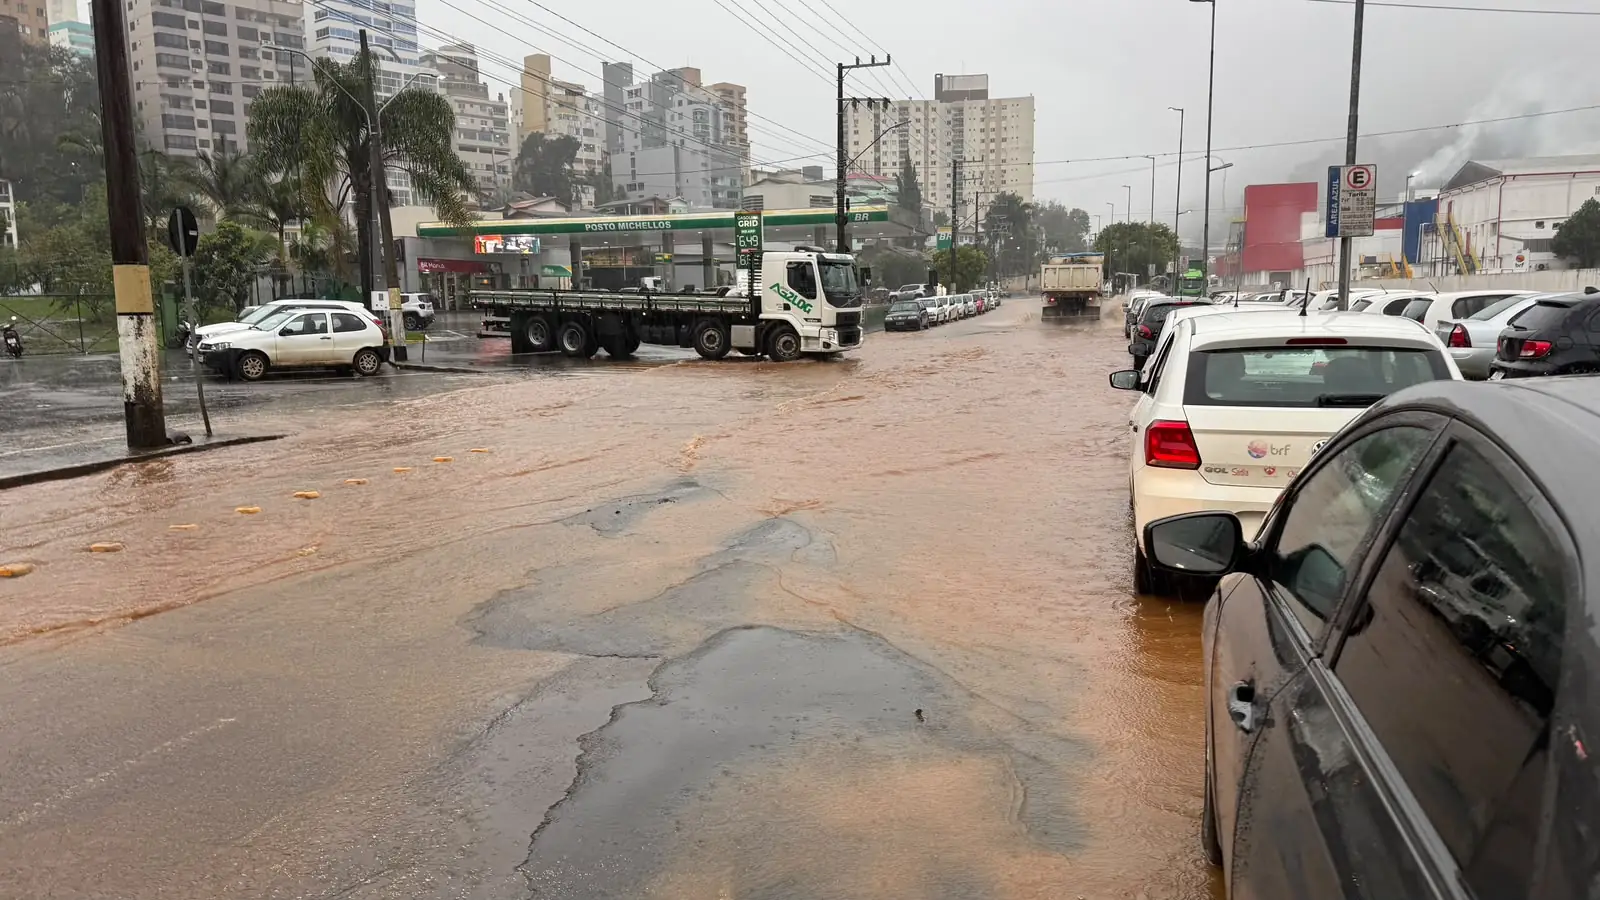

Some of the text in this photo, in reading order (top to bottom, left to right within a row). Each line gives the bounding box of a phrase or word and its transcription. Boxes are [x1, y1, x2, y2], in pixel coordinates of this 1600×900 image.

[1353, 171, 1364, 184] E
[1331, 179, 1339, 201] AZUL
[854, 213, 869, 221] BR
[585, 221, 671, 231] POSTO MICHELLOS
[939, 232, 952, 241] BR
[1270, 444, 1291, 456] brf
[1204, 466, 1229, 474] GOL
